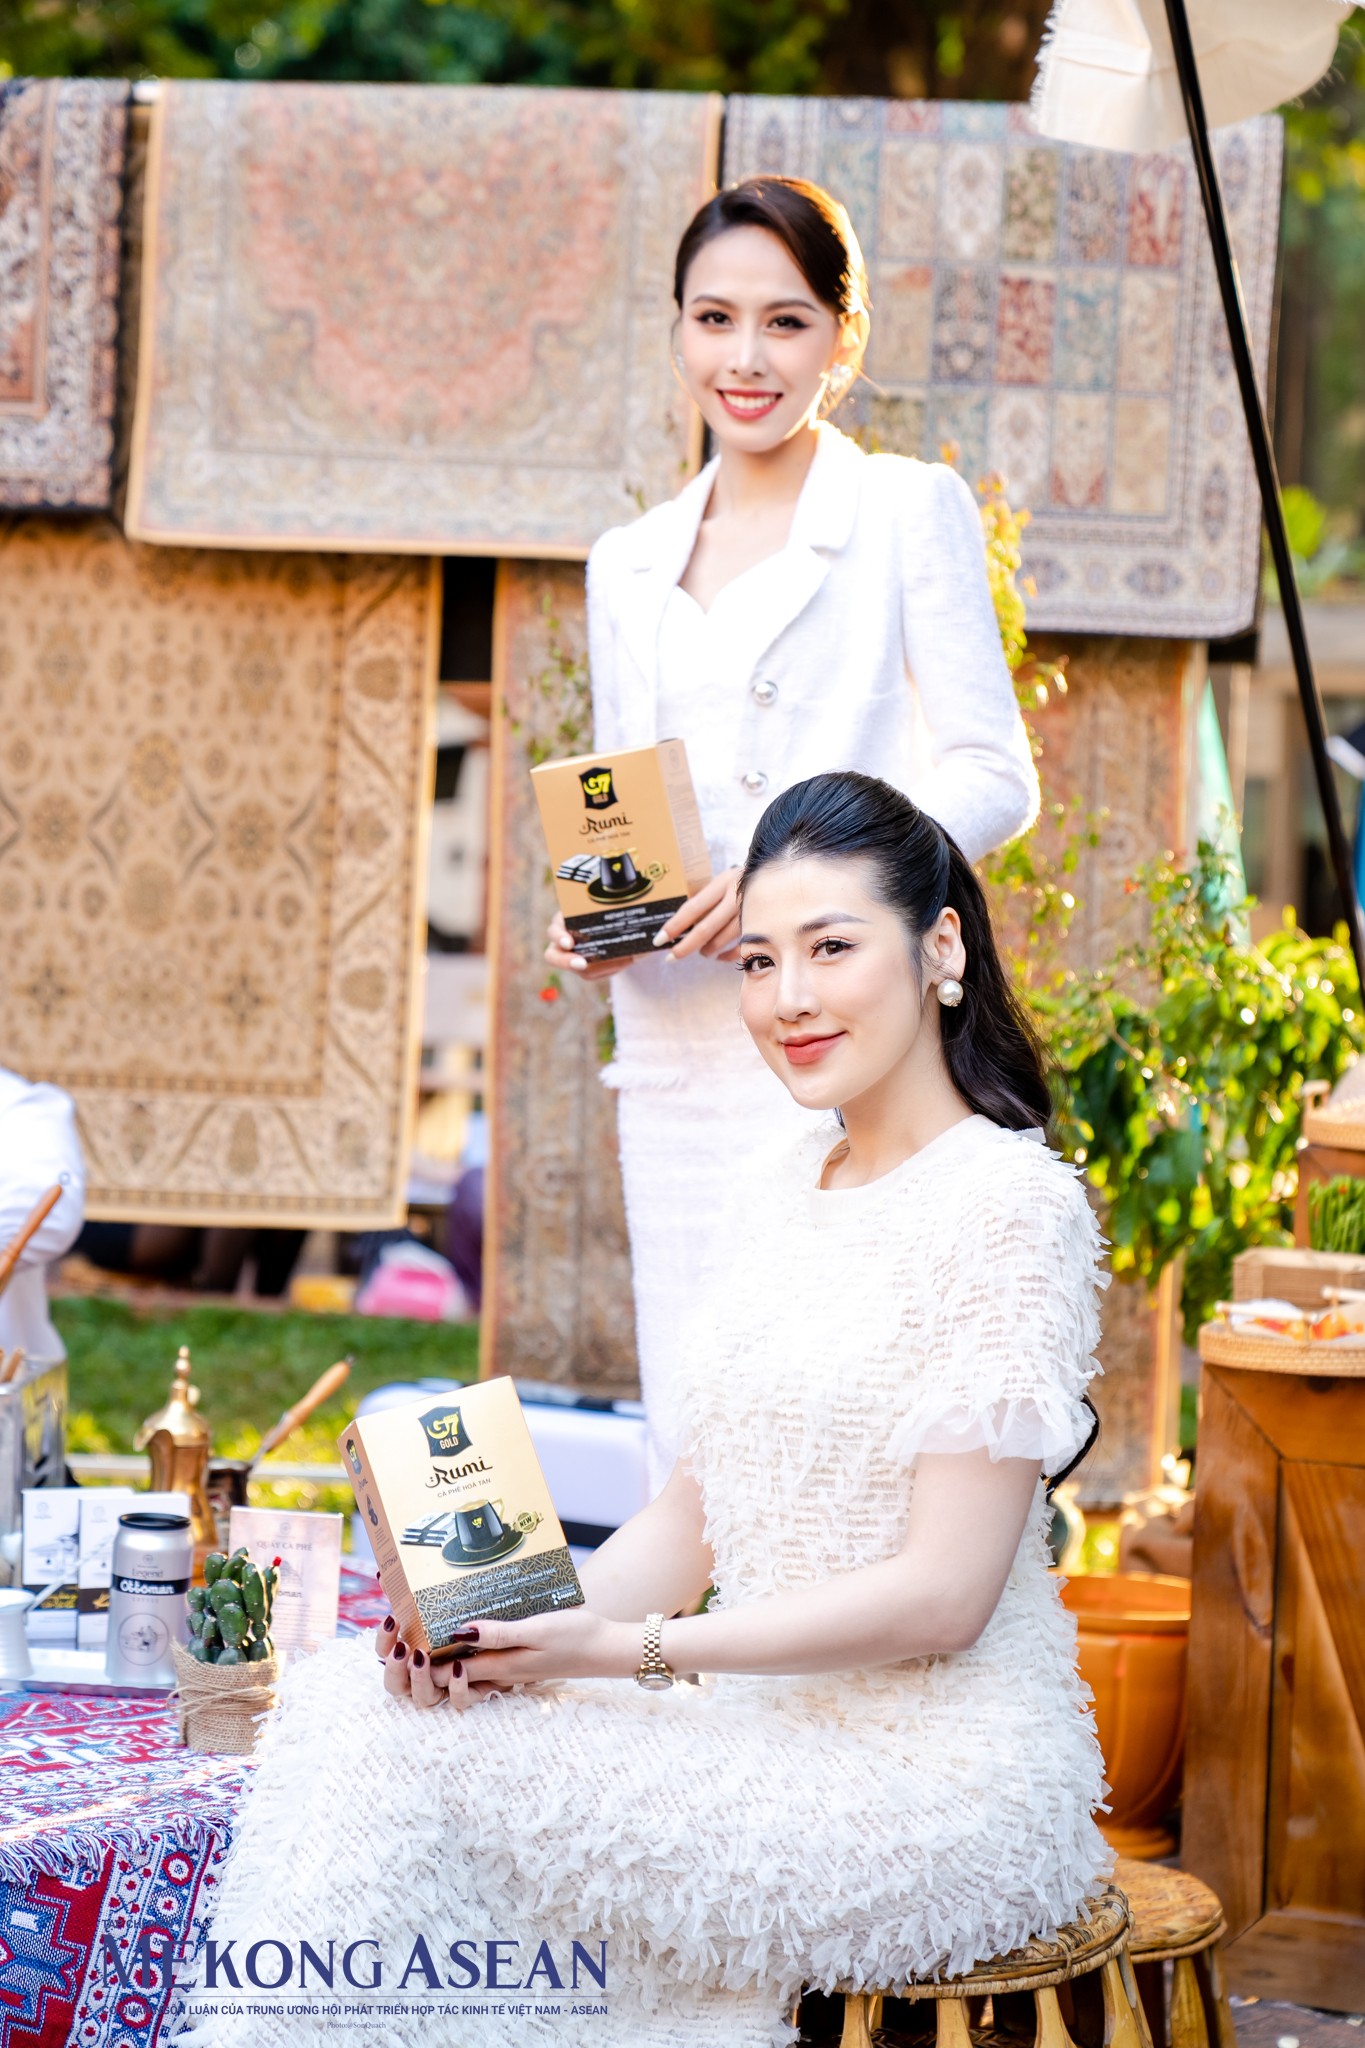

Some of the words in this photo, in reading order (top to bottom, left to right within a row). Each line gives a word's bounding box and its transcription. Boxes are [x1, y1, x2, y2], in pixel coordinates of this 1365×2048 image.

[583, 773, 611, 796] G7
[579, 812, 633, 835] Rumi
[427, 1413, 459, 1440] G7
[439, 1436, 459, 1450] GOLD
[425, 1456, 493, 1488] Rumi
[448, 1486, 462, 1496] PHÊ
[478, 1477, 491, 1487] TAN
[519, 1515, 532, 1528] NEW
[132, 1568, 164, 1579] Legend
[467, 1574, 494, 1587] INSTANT
[494, 1567, 519, 1580] COFFEE
[120, 1579, 174, 1595] Ottoman
